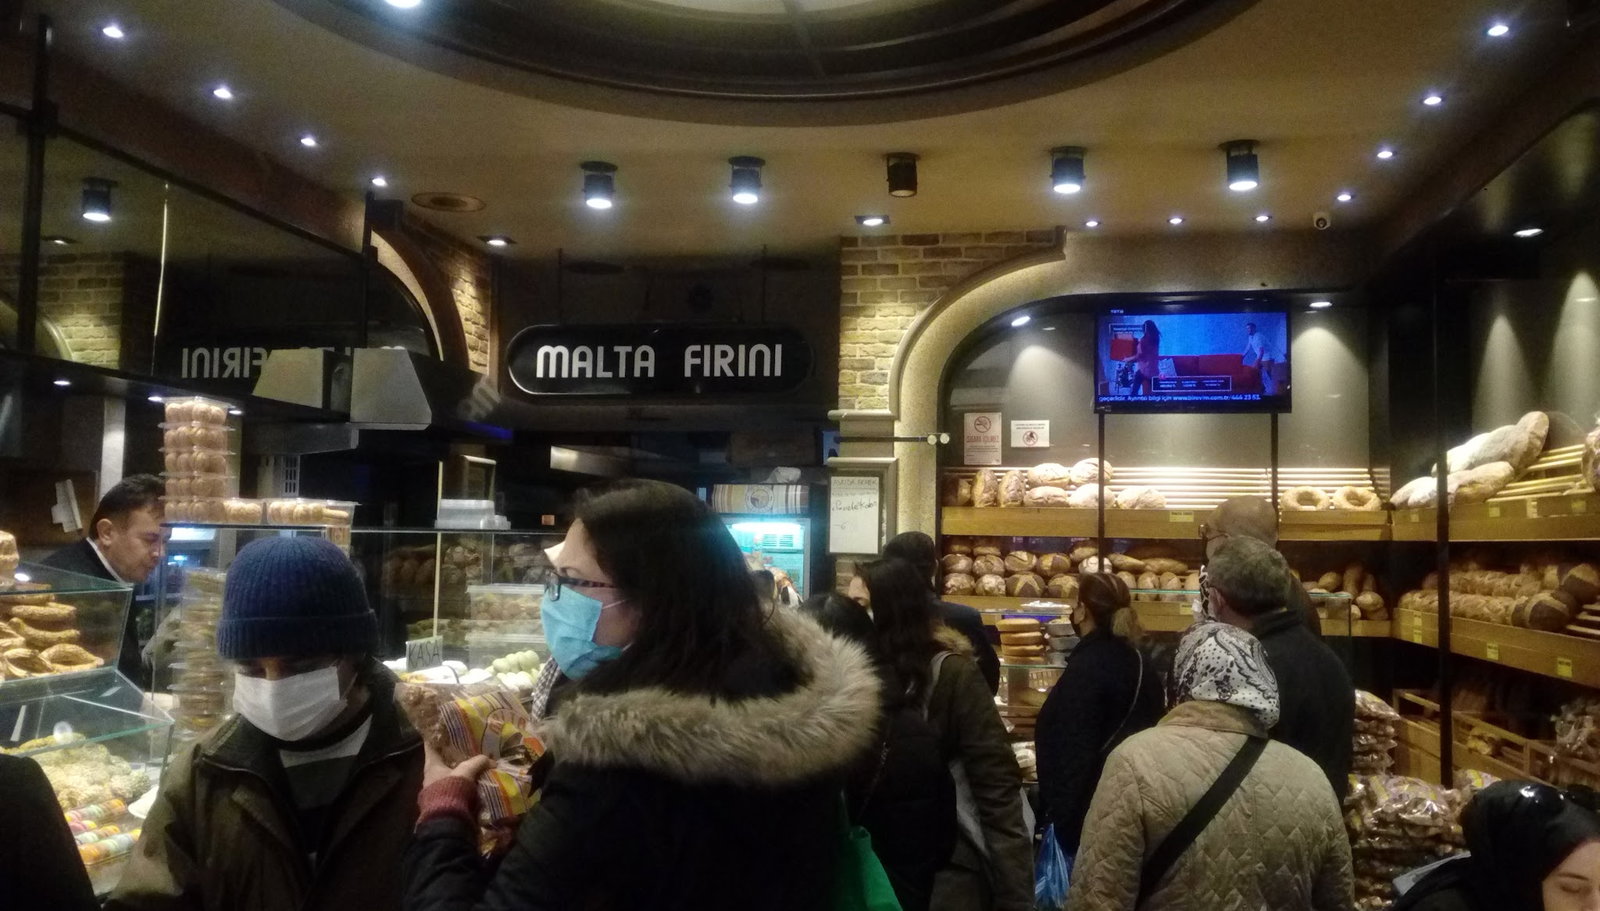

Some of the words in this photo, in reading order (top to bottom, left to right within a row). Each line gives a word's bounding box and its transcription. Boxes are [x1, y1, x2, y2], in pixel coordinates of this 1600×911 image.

[536, 345, 655, 378] MALTA
[684, 344, 782, 377] FIRINI
[408, 640, 441, 669] KASA
